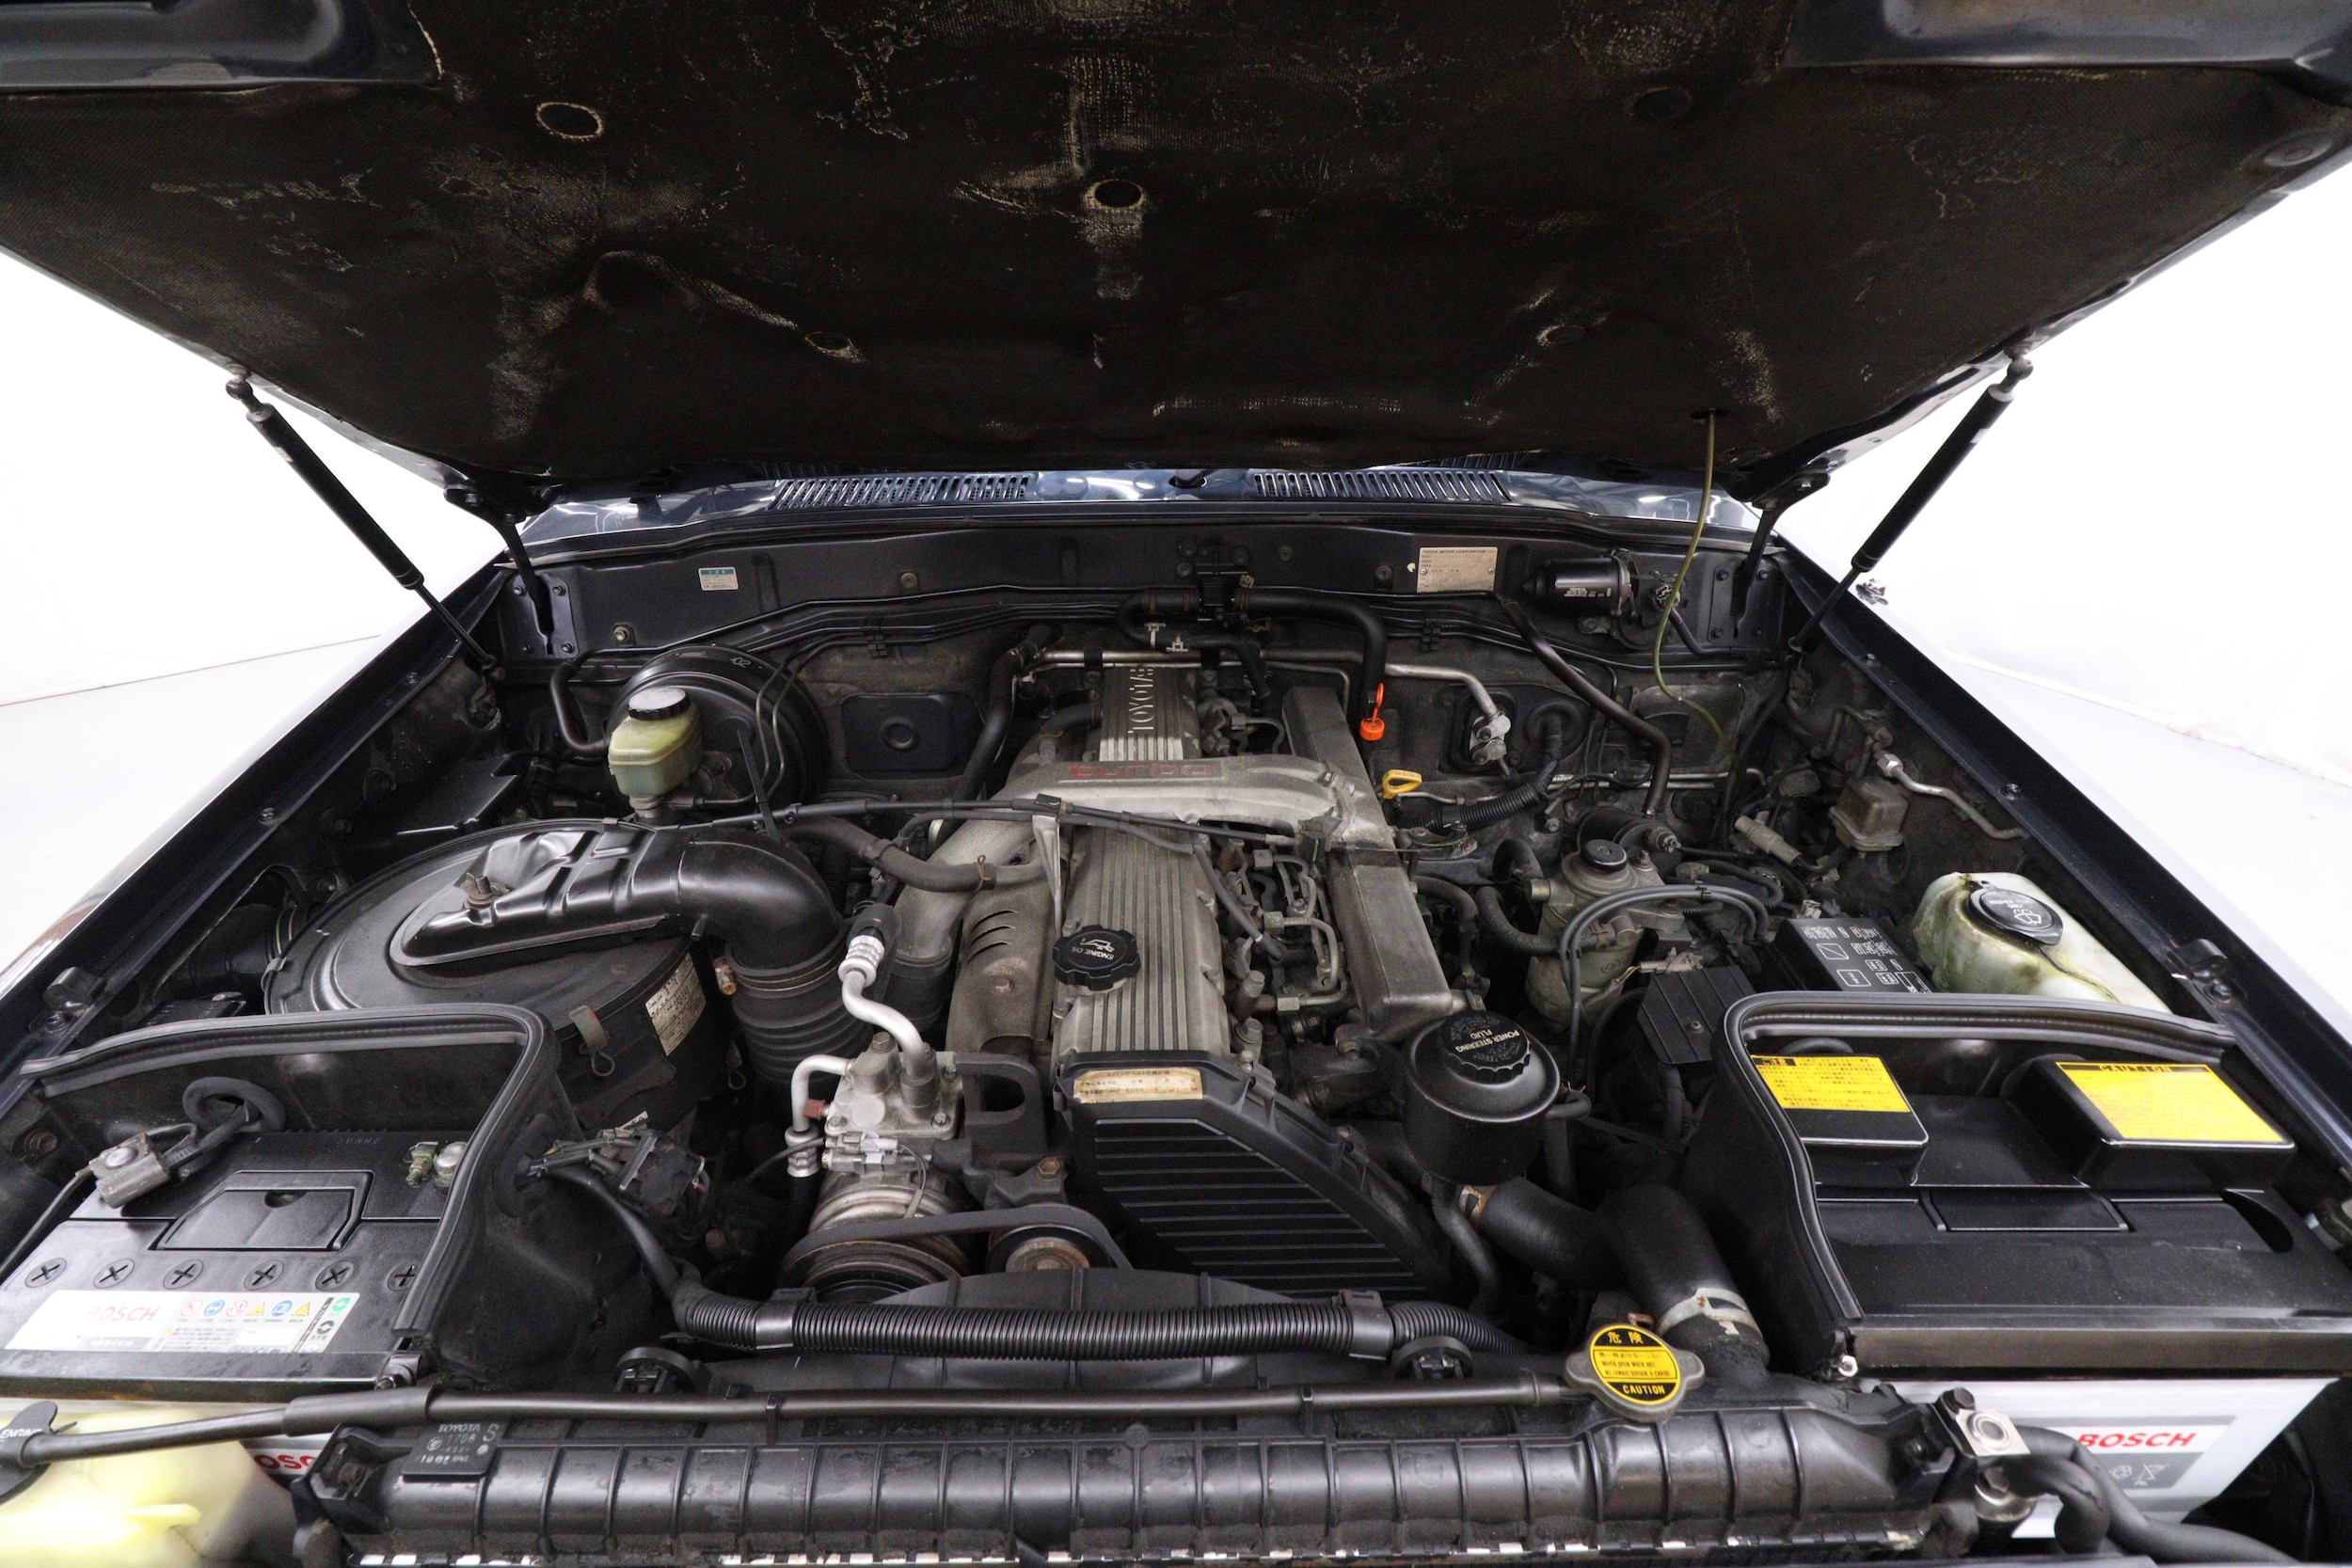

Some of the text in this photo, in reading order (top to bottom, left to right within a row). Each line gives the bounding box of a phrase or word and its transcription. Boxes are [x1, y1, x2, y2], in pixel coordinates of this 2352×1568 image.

[1128, 672, 1154, 734] TOYOTA
[1084, 949, 1115, 960] ENGINE
[1470, 1028, 1493, 1039] FLUID
[1492, 1029, 1520, 1043] POWER
[1454, 1037, 1493, 1053] STEERING
[2099, 1065, 2172, 1073] CAUTION
[86, 1306, 161, 1323] BOSCH
[1622, 1384, 1666, 1395] CAUTION
[438, 1423, 481, 1433] TOYOTA
[2077, 1432, 2198, 1448] BOSCH
[253, 1453, 318, 1470] OSC
